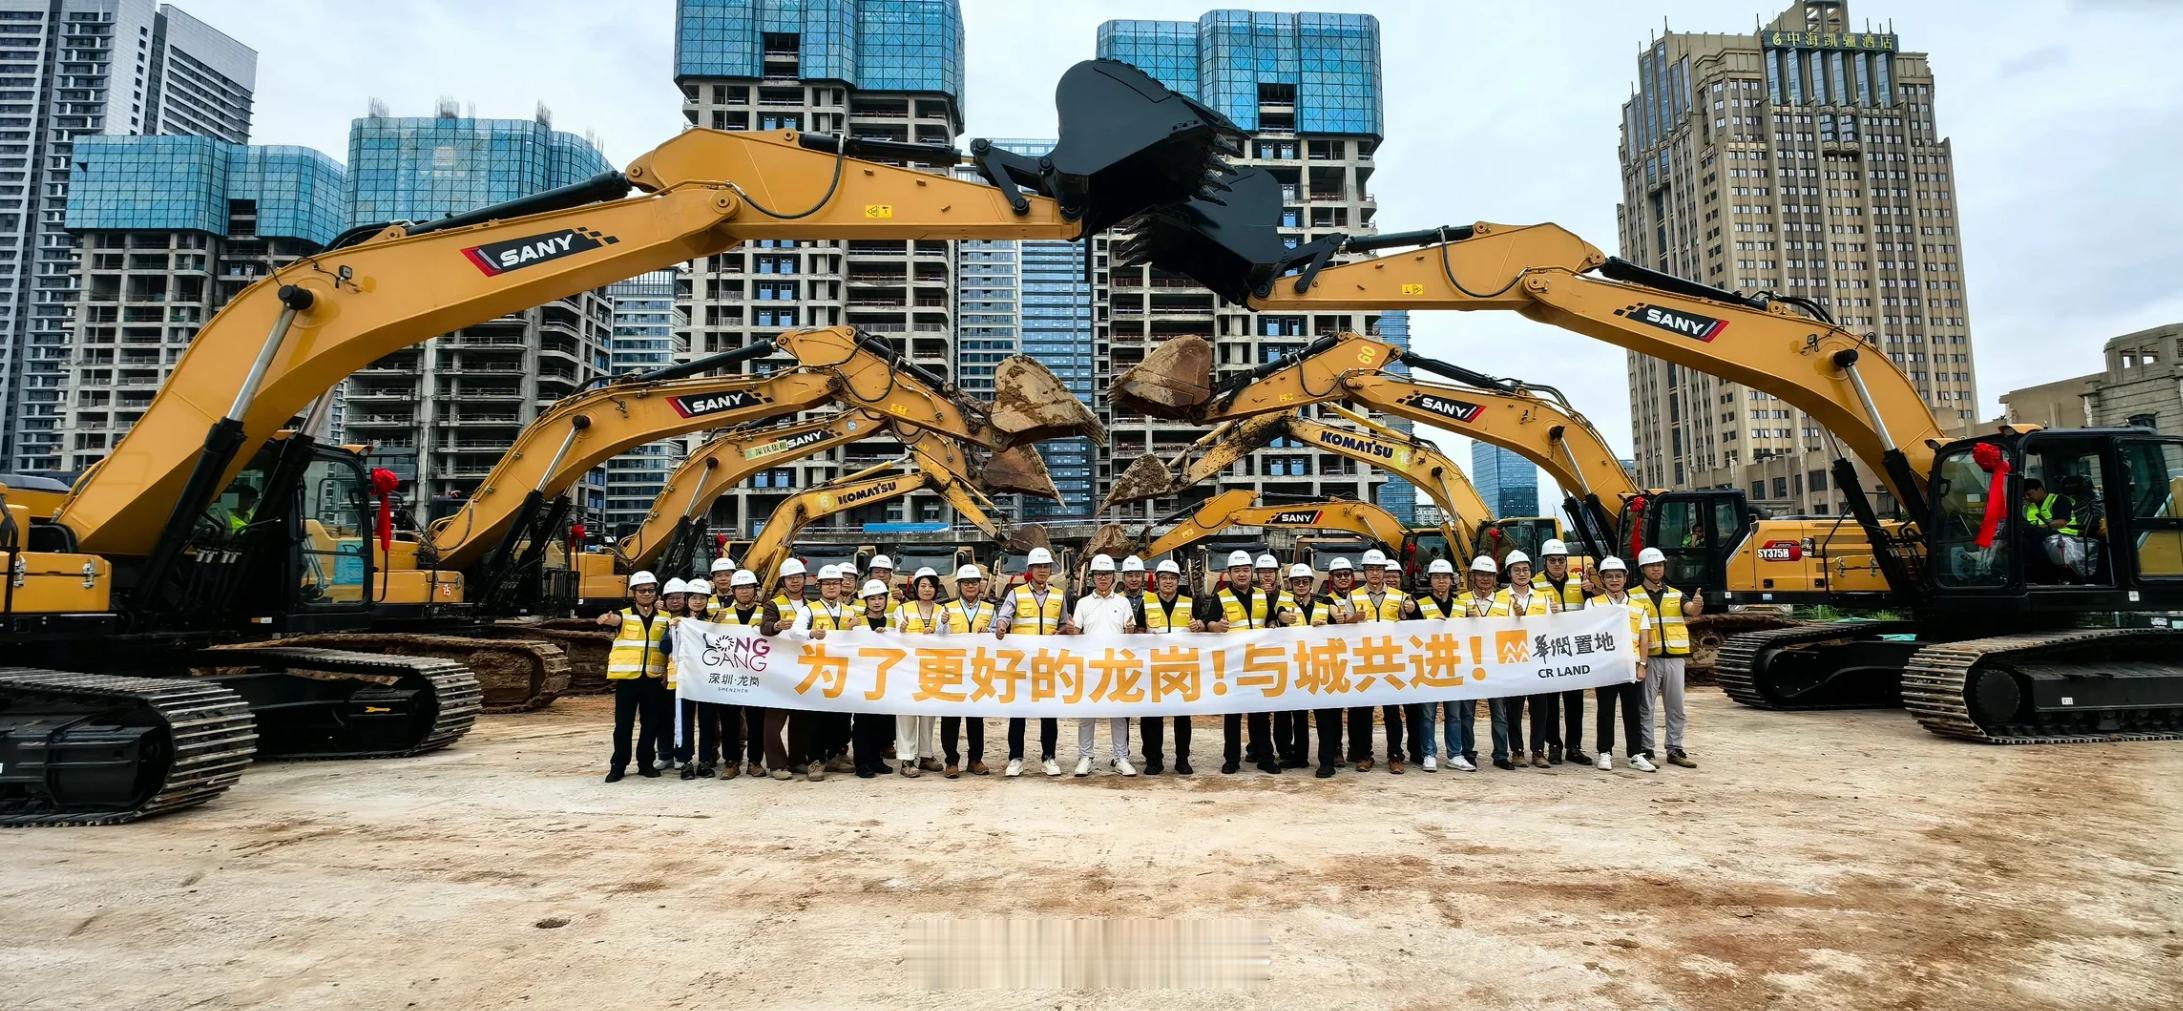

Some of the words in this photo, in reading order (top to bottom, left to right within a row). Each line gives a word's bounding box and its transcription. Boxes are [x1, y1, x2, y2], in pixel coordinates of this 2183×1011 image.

[500, 233, 573, 268] SANY
[1646, 308, 1704, 335] SANY
[692, 393, 743, 413] SANY
[1421, 397, 1467, 417] SANY
[787, 430, 821, 449] SANY
[1320, 430, 1393, 459] KOMATSU
[837, 481, 897, 505] KOMATSU
[1281, 513, 1312, 523] SANY
[701, 648, 768, 672] GANG
[1537, 668, 1555, 679] CR
[1557, 664, 1591, 677] LAND
